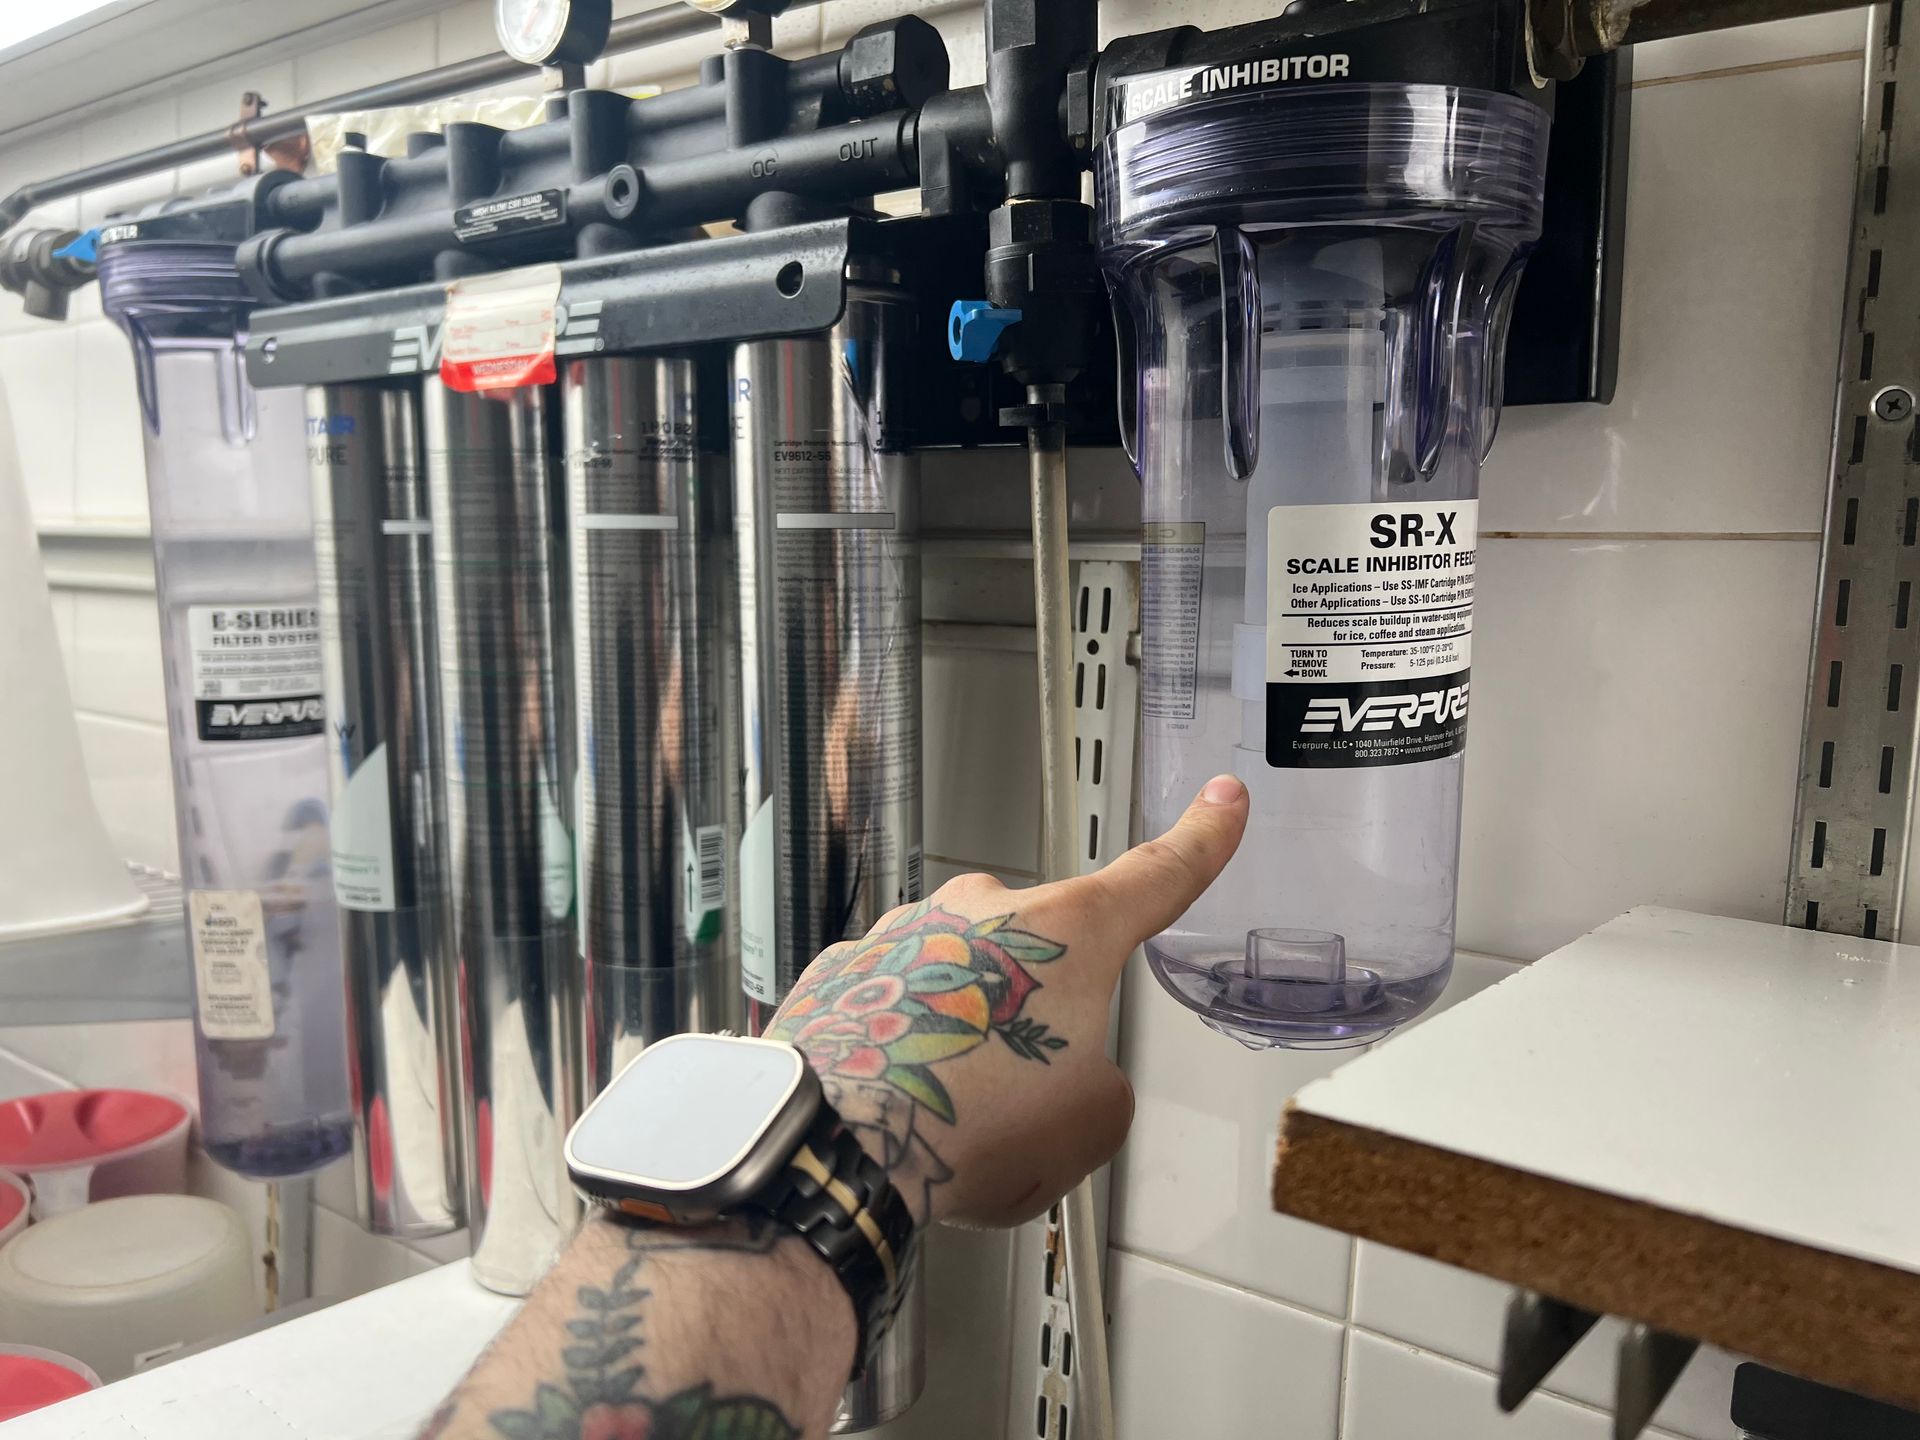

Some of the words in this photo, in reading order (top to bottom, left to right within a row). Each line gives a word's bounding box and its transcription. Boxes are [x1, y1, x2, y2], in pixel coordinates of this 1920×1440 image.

[1131, 78, 1193, 112] SCALE
[1201, 53, 1350, 94] INHIBITOR
[838, 136, 878, 162] OUT
[1369, 512, 1457, 549] SR-X
[1286, 557, 1359, 575] SCALE
[1366, 553, 1451, 573] INHIBITOR
[1292, 583, 1308, 593] Ice
[1310, 582, 1372, 596] Applications
[1382, 581, 1399, 591] Use
[1401, 578, 1429, 590] SS-IMF
[1430, 576, 1456, 588] Cartridge
[1290, 598, 1318, 609] Other
[1320, 597, 1381, 610] Applications
[1390, 596, 1407, 606] Use
[1408, 594, 1430, 605] SS-10
[1431, 591, 1456, 603] Cartridge
[1307, 617, 1350, 628] Reduces
[1352, 616, 1378, 627] scale
[1379, 614, 1411, 627] buildup
[1412, 614, 1420, 624] in
[1421, 610, 1456, 623] water-using
[212, 633, 262, 648] FILTER
[1333, 630, 1347, 641] for
[1349, 630, 1367, 641] ice,
[1369, 628, 1397, 640] coffee
[1399, 627, 1413, 638] and
[1415, 627, 1436, 637] steam
[1290, 650, 1314, 658] TURN
[1316, 650, 1328, 658] TO
[1361, 649, 1409, 660] Temperature:
[1291, 659, 1328, 668] REMOVE
[1361, 661, 1396, 670] Pressure:
[1409, 658, 1426, 667] 5-125
[1426, 657, 1435, 667] psi
[1301, 669, 1328, 678] BOWL
[1300, 681, 1469, 733] EVERPURE
[1292, 740, 1332, 750] Everpure,
[1333, 740, 1348, 749] LLC
[1355, 739, 1372, 748] 1040
[1373, 737, 1405, 748] Muirfield
[1405, 736, 1423, 746] Drive,
[1354, 747, 1400, 758] 800.323.7873
